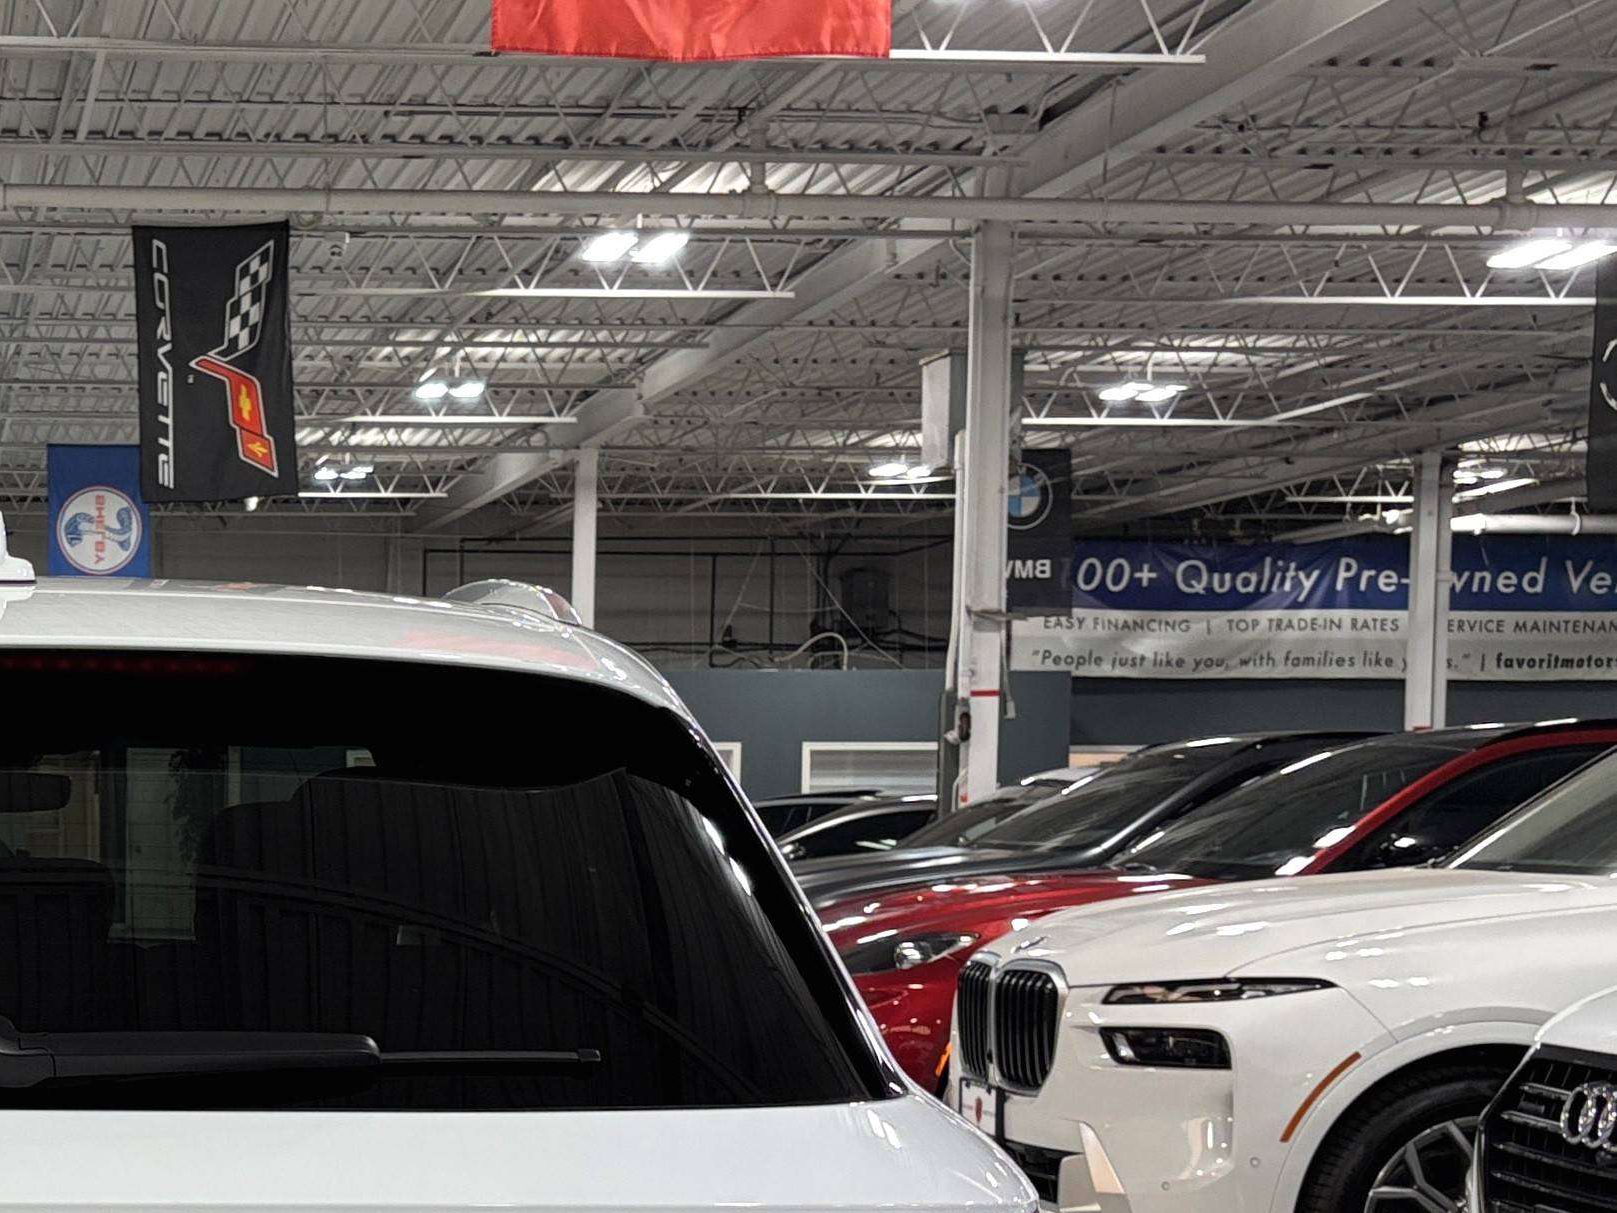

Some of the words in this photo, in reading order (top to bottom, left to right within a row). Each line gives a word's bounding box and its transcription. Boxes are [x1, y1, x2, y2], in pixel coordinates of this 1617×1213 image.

[151, 238, 174, 489] CORVETTE
[1175, 556, 1321, 602] Quality
[1564, 559, 1617, 595] Ve
[1043, 615, 1086, 630] EASY
[1092, 617, 1192, 634] FINANCING
[1226, 618, 1260, 632] TOP
[1268, 617, 1343, 632] TRADE-IN
[1350, 617, 1400, 632] RATES
[1446, 619, 1505, 634] ERVICE
[1111, 651, 1146, 670] just
[1152, 652, 1186, 668] like
[1191, 656, 1229, 673] you,
[1238, 651, 1276, 668] with
[1283, 650, 1355, 669] families
[1362, 650, 1394, 667] like
[1494, 652, 1617, 670] favoritmotor
